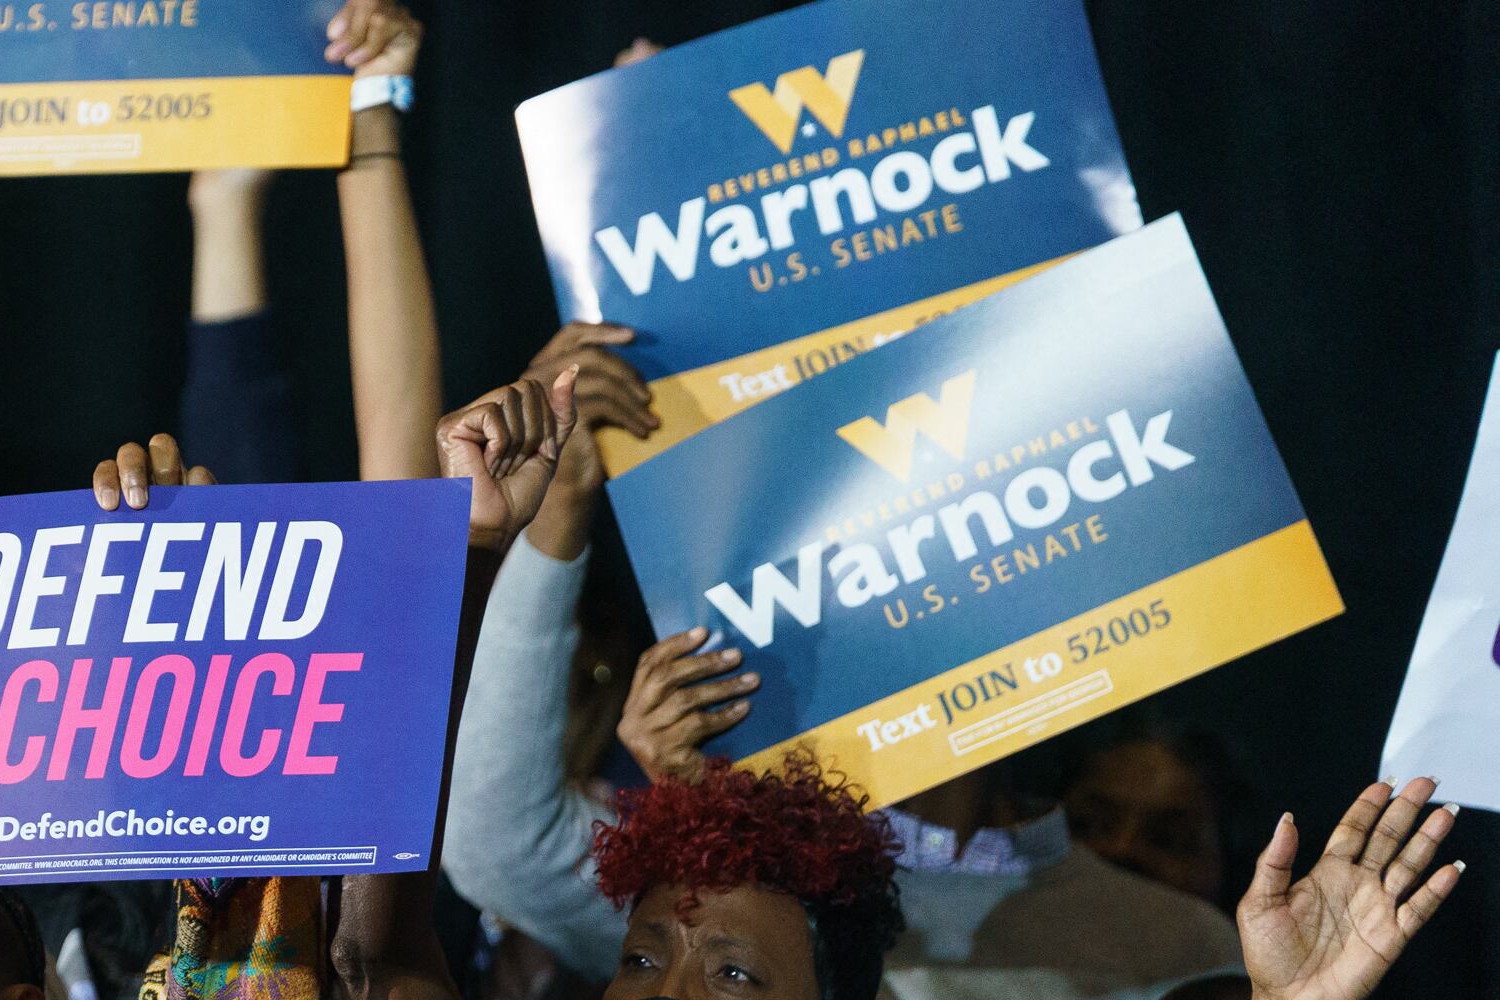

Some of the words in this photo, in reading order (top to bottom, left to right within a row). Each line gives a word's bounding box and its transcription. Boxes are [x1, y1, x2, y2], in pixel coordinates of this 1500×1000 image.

[70, 0, 199, 29] SENATE
[76, 99, 112, 126] to
[117, 93, 213, 121] 52005
[707, 147, 840, 203] REVEREND
[848, 107, 966, 158] RAPHAEL
[594, 104, 1051, 297] Warnock
[749, 254, 821, 292] U.S.
[829, 204, 965, 269] SENATE
[704, 408, 1197, 648] Warnock
[824, 472, 967, 544] REVEREND
[974, 415, 1100, 477] RAPHAEL
[883, 586, 960, 629] U.S.
[970, 513, 1108, 593] SENATE
[856, 702, 938, 752] Text
[936, 662, 1019, 725] JOIN
[1023, 651, 1064, 684] to
[1067, 599, 1171, 664] 52005
[105, 858, 118, 866] THIS
[118, 856, 172, 866] COMMUNICATION
[179, 856, 192, 865] NOT
[192, 855, 230, 864] AUTHORIZED
[240, 854, 253, 863] ANY
[253, 853, 286, 862] CANDIDATE
[287, 853, 297, 861] OR
[337, 851, 373, 861] COMMITTEE
